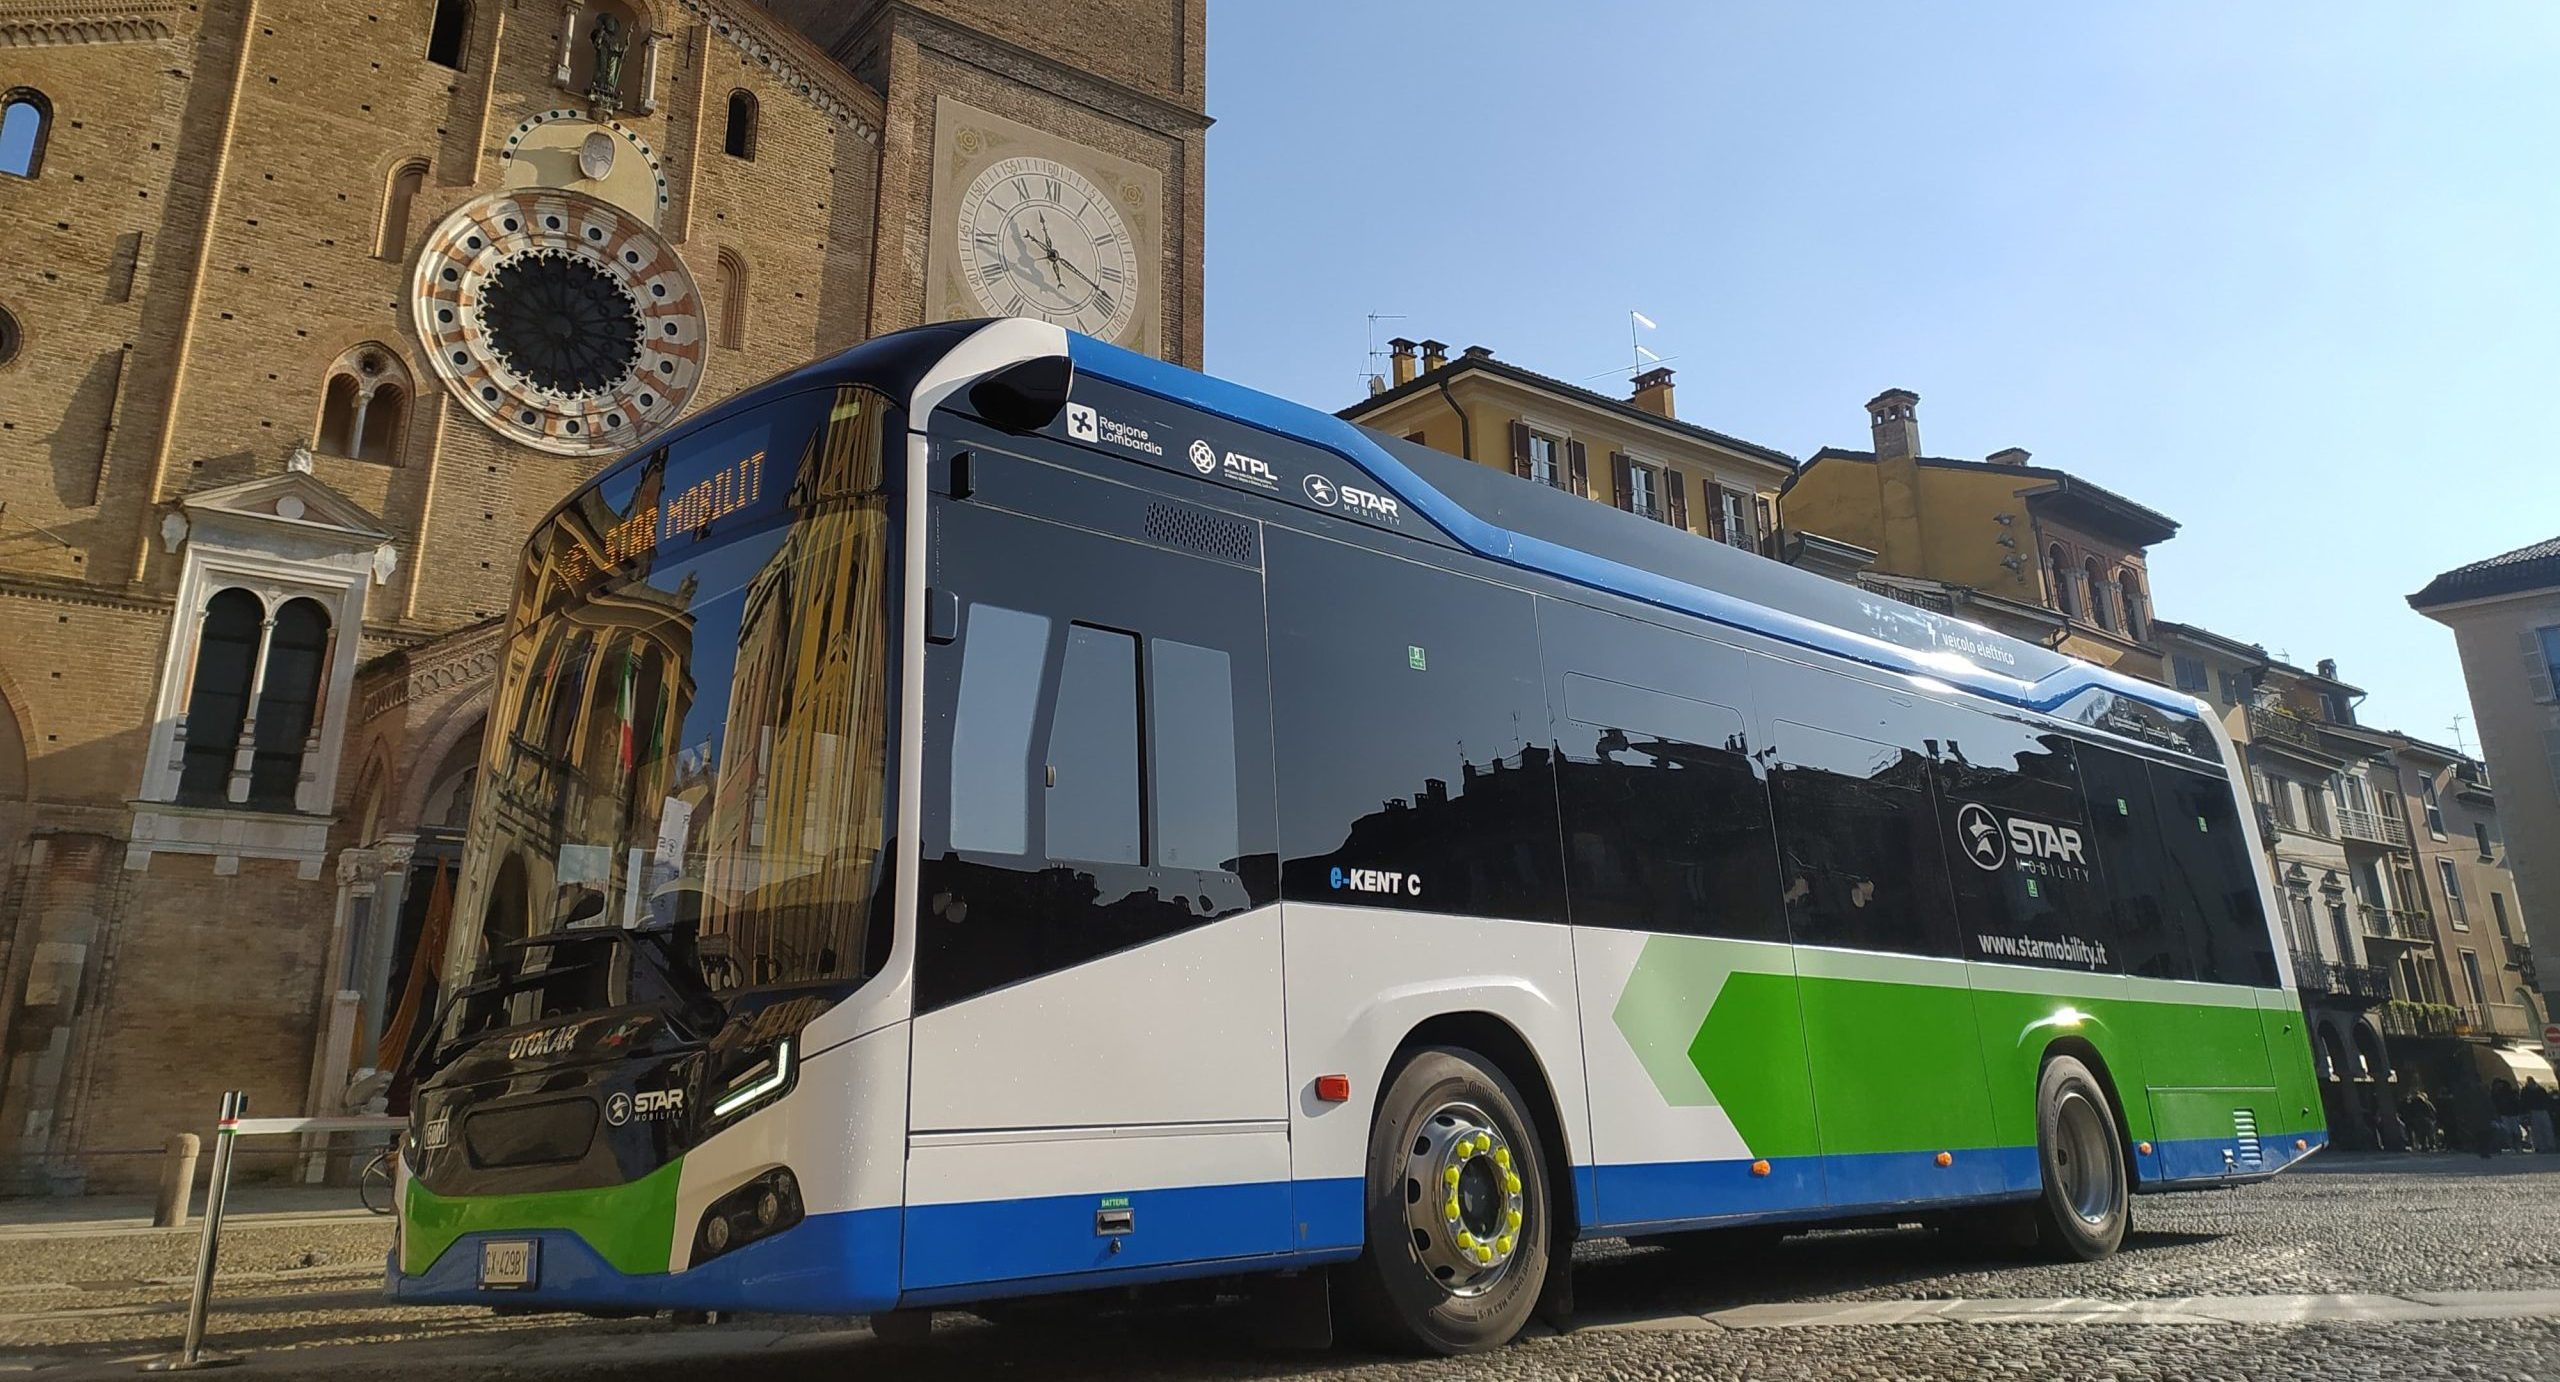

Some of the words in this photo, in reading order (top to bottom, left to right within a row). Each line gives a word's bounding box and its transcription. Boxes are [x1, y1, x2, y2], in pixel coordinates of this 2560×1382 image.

[1011, 177, 1031, 203] XI
[1044, 178, 1062, 205] XII
[986, 194, 1008, 218] X
[975, 227, 998, 247] IX
[1094, 233, 1115, 247] II
[980, 263, 1005, 287] VIII
[1101, 266, 1122, 284] III
[1099, 416, 1149, 440] Regione
[1100, 428, 1163, 456] Lombardia
[1223, 451, 1279, 481] ATPL
[603, 506, 658, 570] STAR
[665, 451, 765, 539] MOBILIT
[1340, 485, 1399, 518] STAR
[1343, 503, 1401, 526] MOBILITY
[1942, 632, 1976, 654] veicolo
[1977, 642, 2015, 666] elettrico
[2007, 817, 2087, 865] STAR
[1330, 866, 1402, 894] e-KENT
[1407, 874, 1421, 896] C
[2015, 858, 2090, 883] MOBILITY
[1978, 934, 2108, 971] www.starmobility.it
[508, 1024, 579, 1060] OTOKAR
[634, 1088, 684, 1113] STAR
[634, 1110, 684, 1122] MOBILITY
